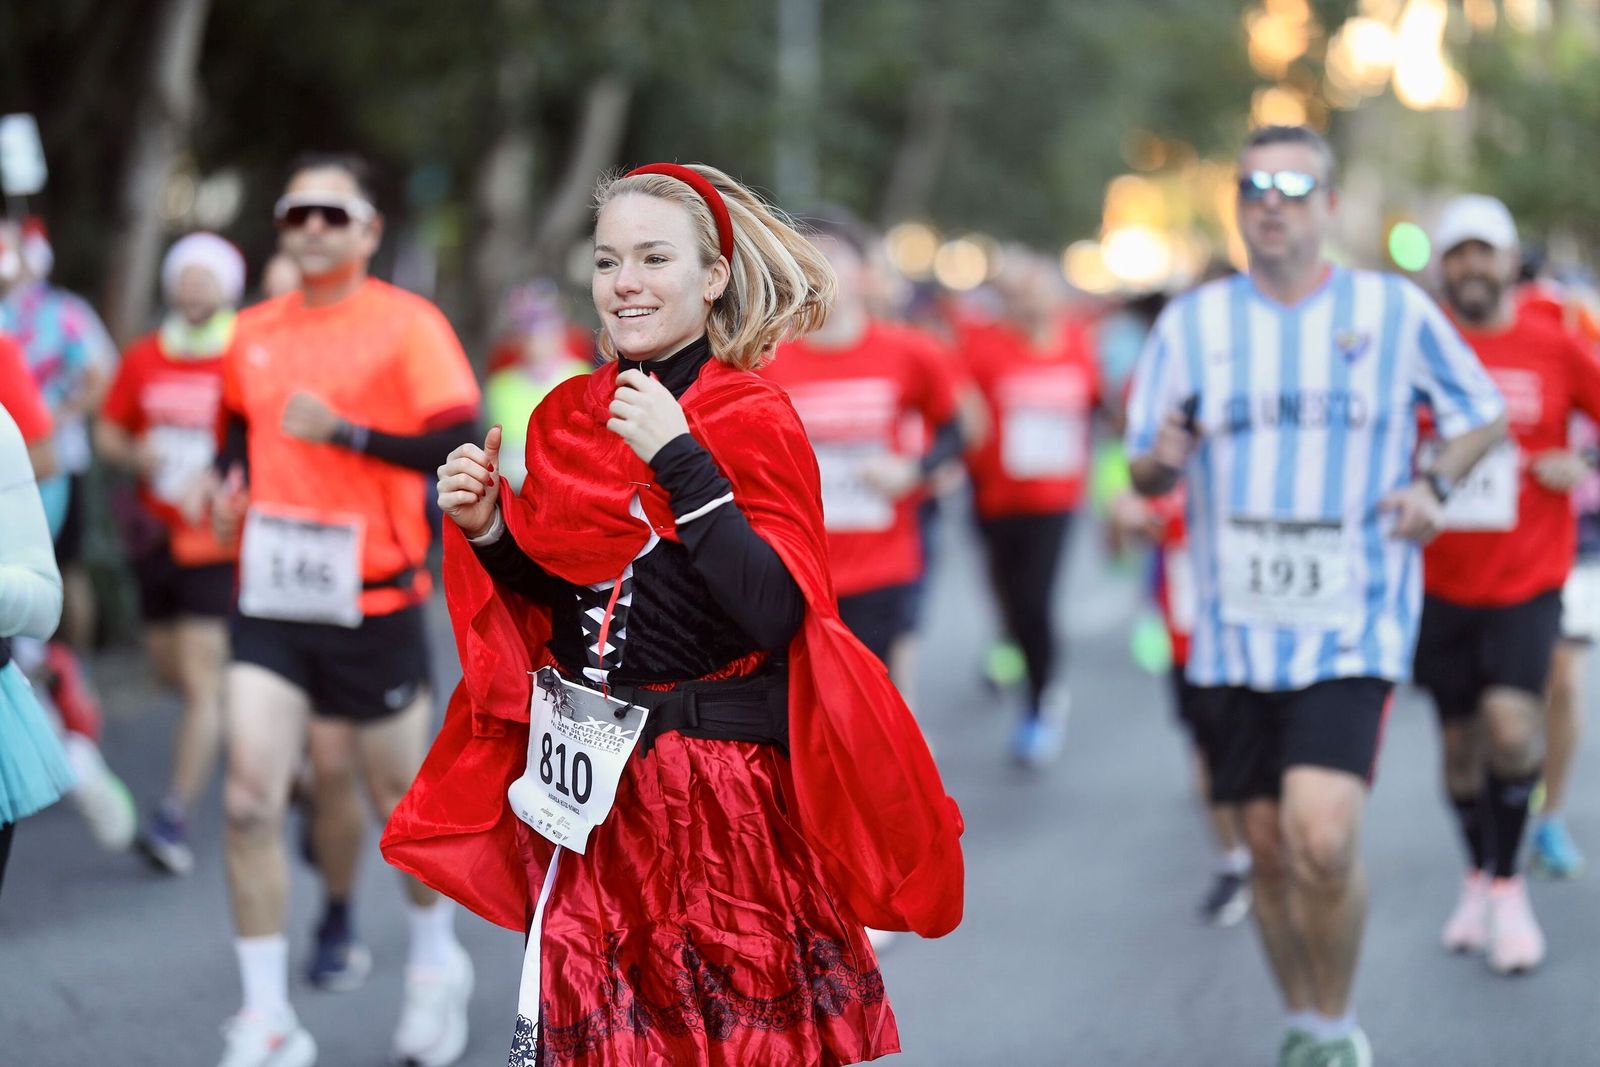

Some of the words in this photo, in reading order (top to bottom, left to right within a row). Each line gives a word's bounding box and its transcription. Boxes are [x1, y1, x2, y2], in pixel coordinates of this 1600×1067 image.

[1248, 555, 1322, 596] 193
[557, 720, 570, 731] SAN
[570, 727, 624, 749] SILVESTRE
[573, 723, 625, 744] CARRERA
[581, 715, 635, 736] XIV
[540, 732, 593, 805] 810
